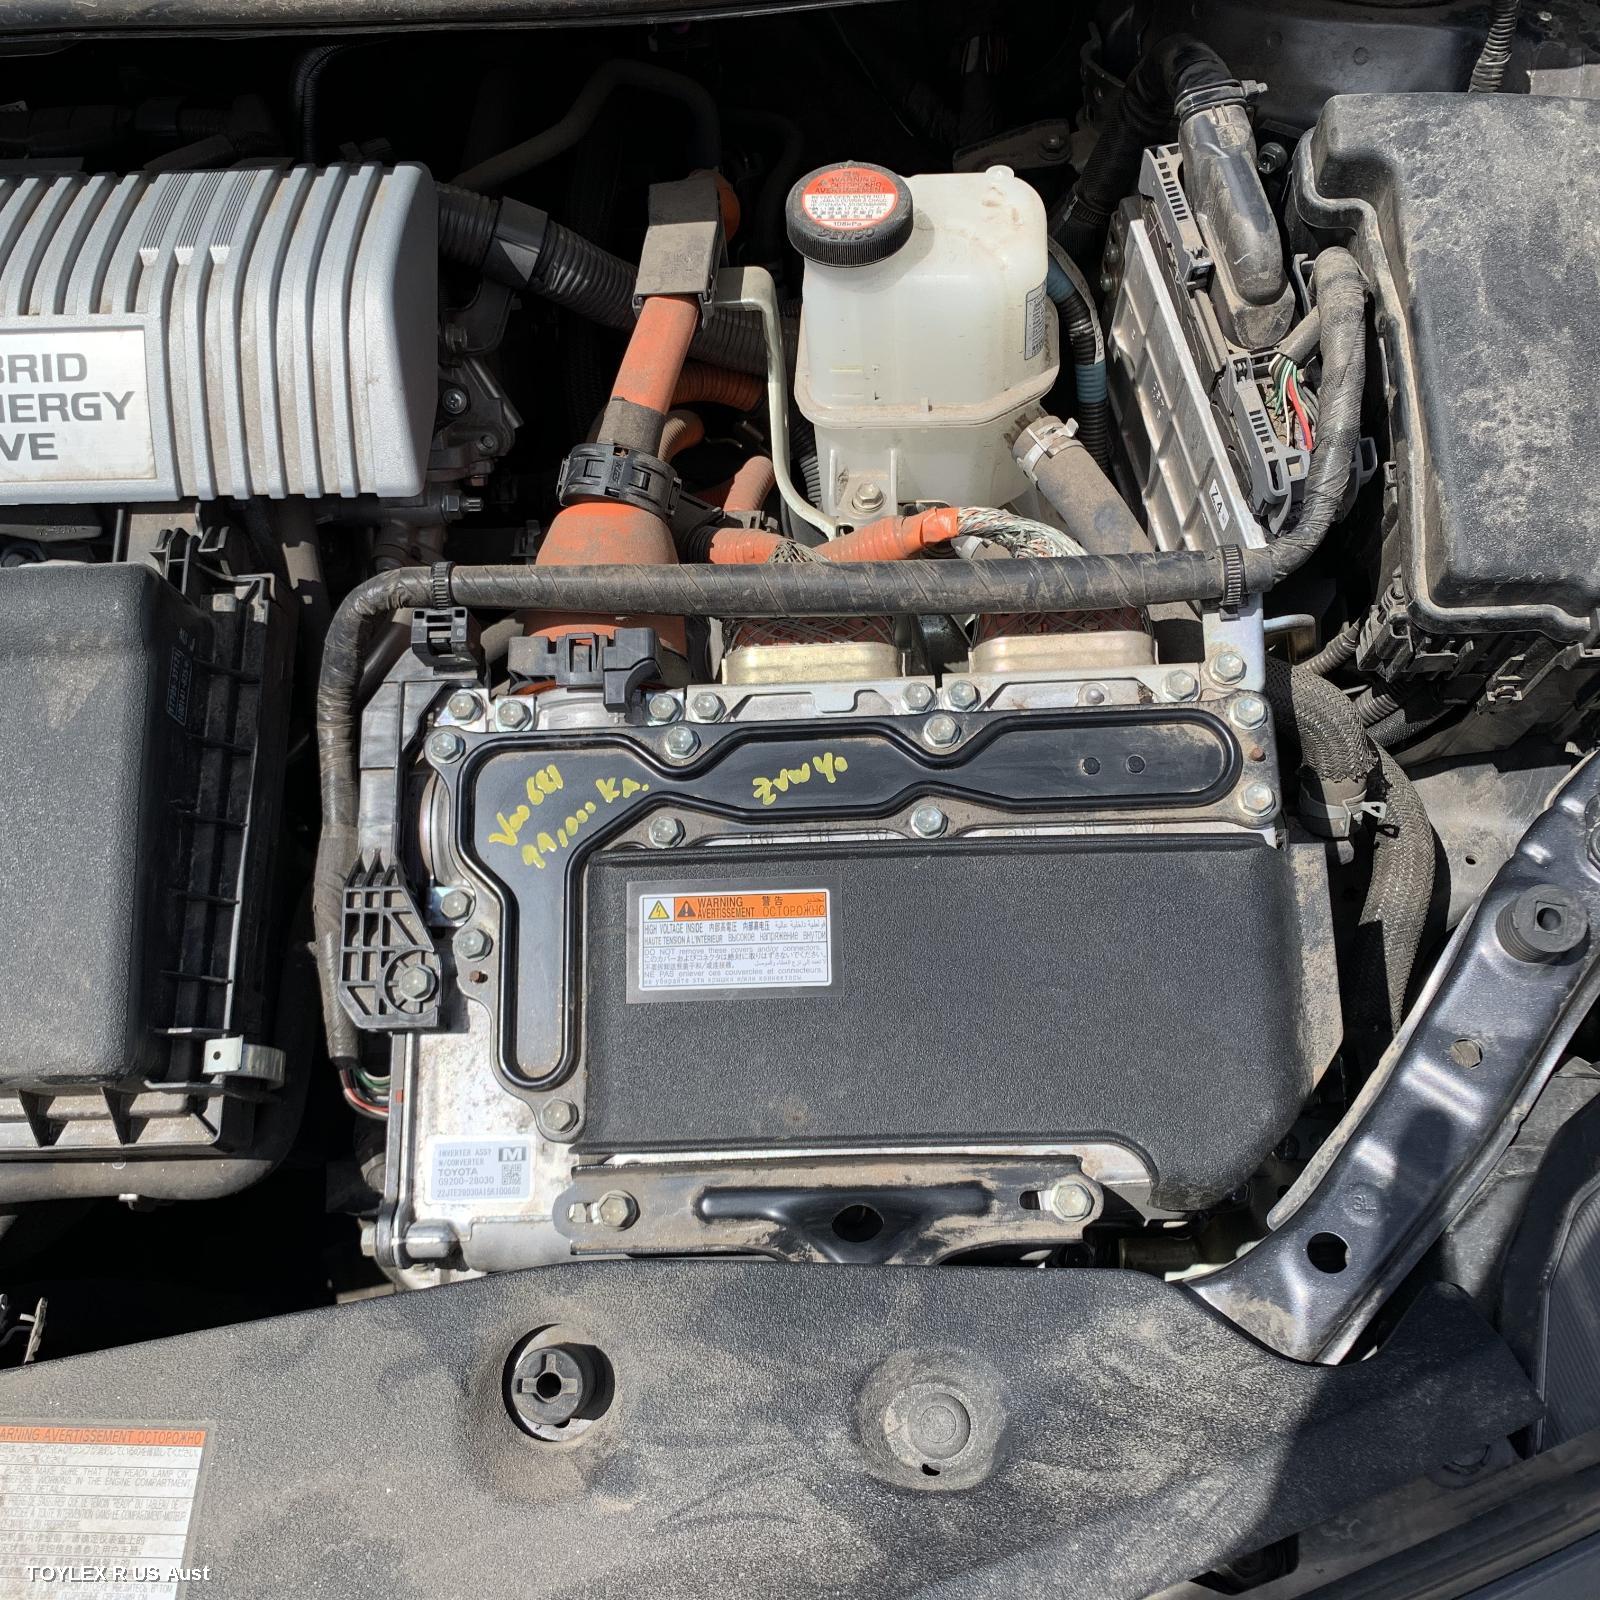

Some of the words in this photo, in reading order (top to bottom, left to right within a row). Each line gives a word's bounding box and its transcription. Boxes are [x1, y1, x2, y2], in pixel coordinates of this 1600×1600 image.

[0, 353, 88, 383] RID
[0, 391, 135, 423] ERGY
[698, 896, 743, 908] WARNING
[698, 907, 755, 919] AVERTISSEMENT
[762, 904, 825, 917] ОСТОРОЖНО
[660, 922, 684, 934] VOLTAGE
[686, 922, 703, 933] INSIDE
[645, 936, 662, 945] HAUTE
[663, 935, 686, 945] TENSION
[437, 1167, 478, 1177] TOYOTA
[45, 1428, 134, 1444] AVERTISSEMENT
[138, 1430, 202, 1445] ОСТОРОЖНО
